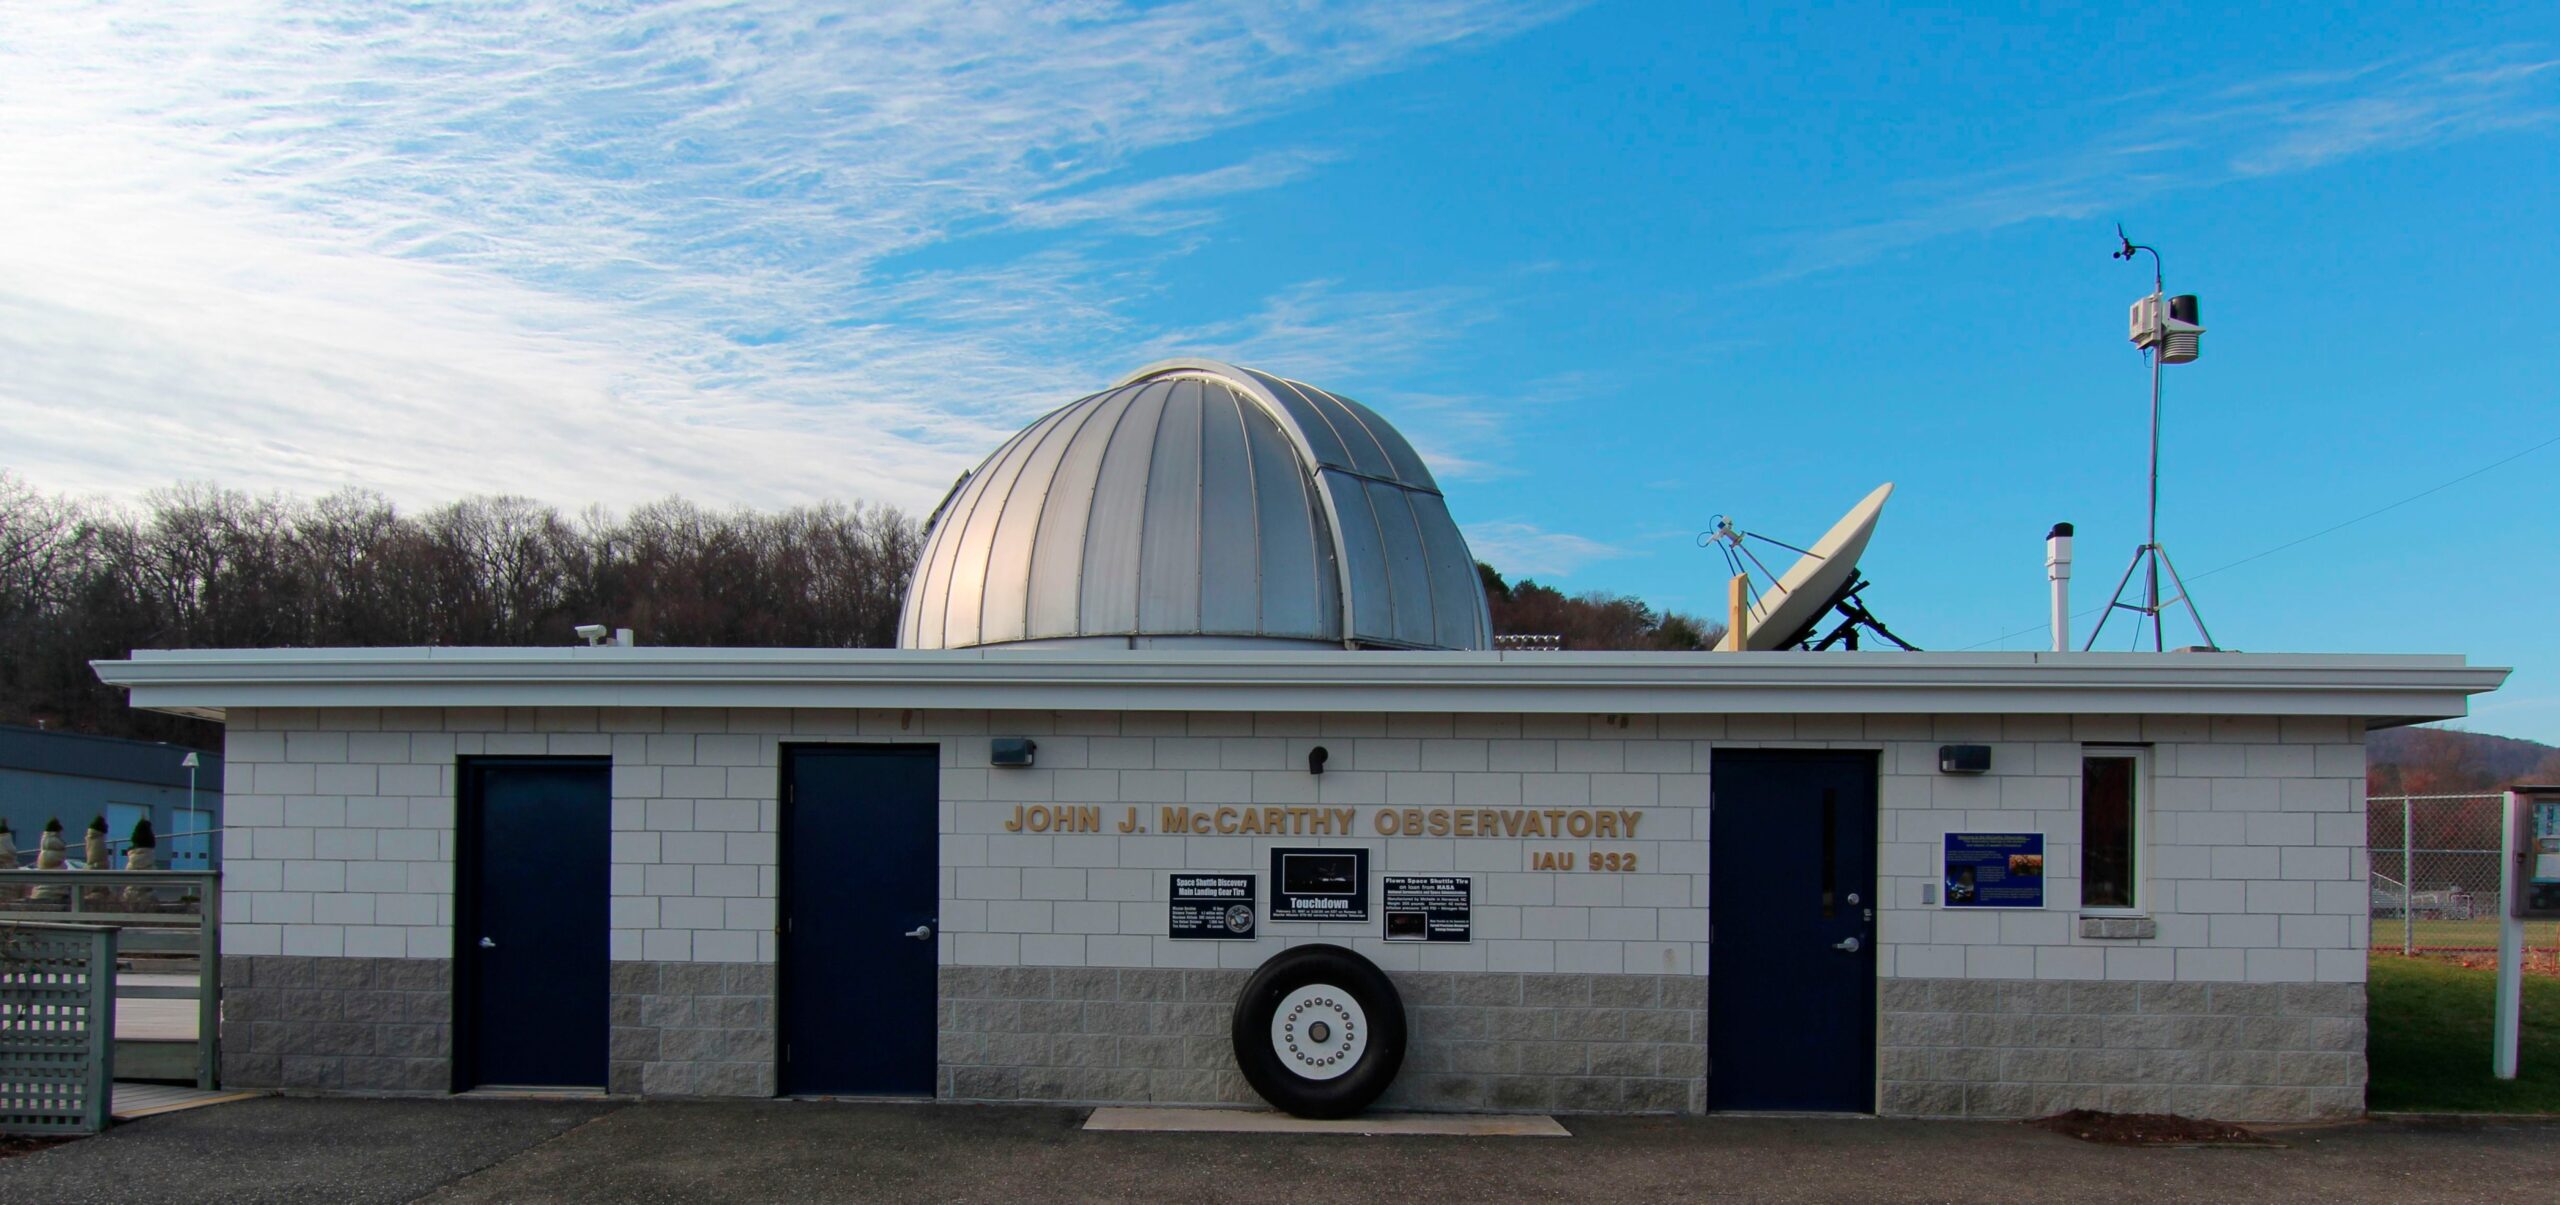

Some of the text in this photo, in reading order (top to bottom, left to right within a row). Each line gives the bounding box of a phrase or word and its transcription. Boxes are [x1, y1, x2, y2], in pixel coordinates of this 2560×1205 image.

[1004, 804, 1643, 838] JOHN J. McCARTHY OBSERVATORY
[1532, 852, 1637, 872] IAU 932
[1176, 878, 1247, 888] Space Shuttle Discovery
[1178, 888, 1245, 897] Main Landing Gear Tire
[1290, 897, 1349, 909] Touchdown
